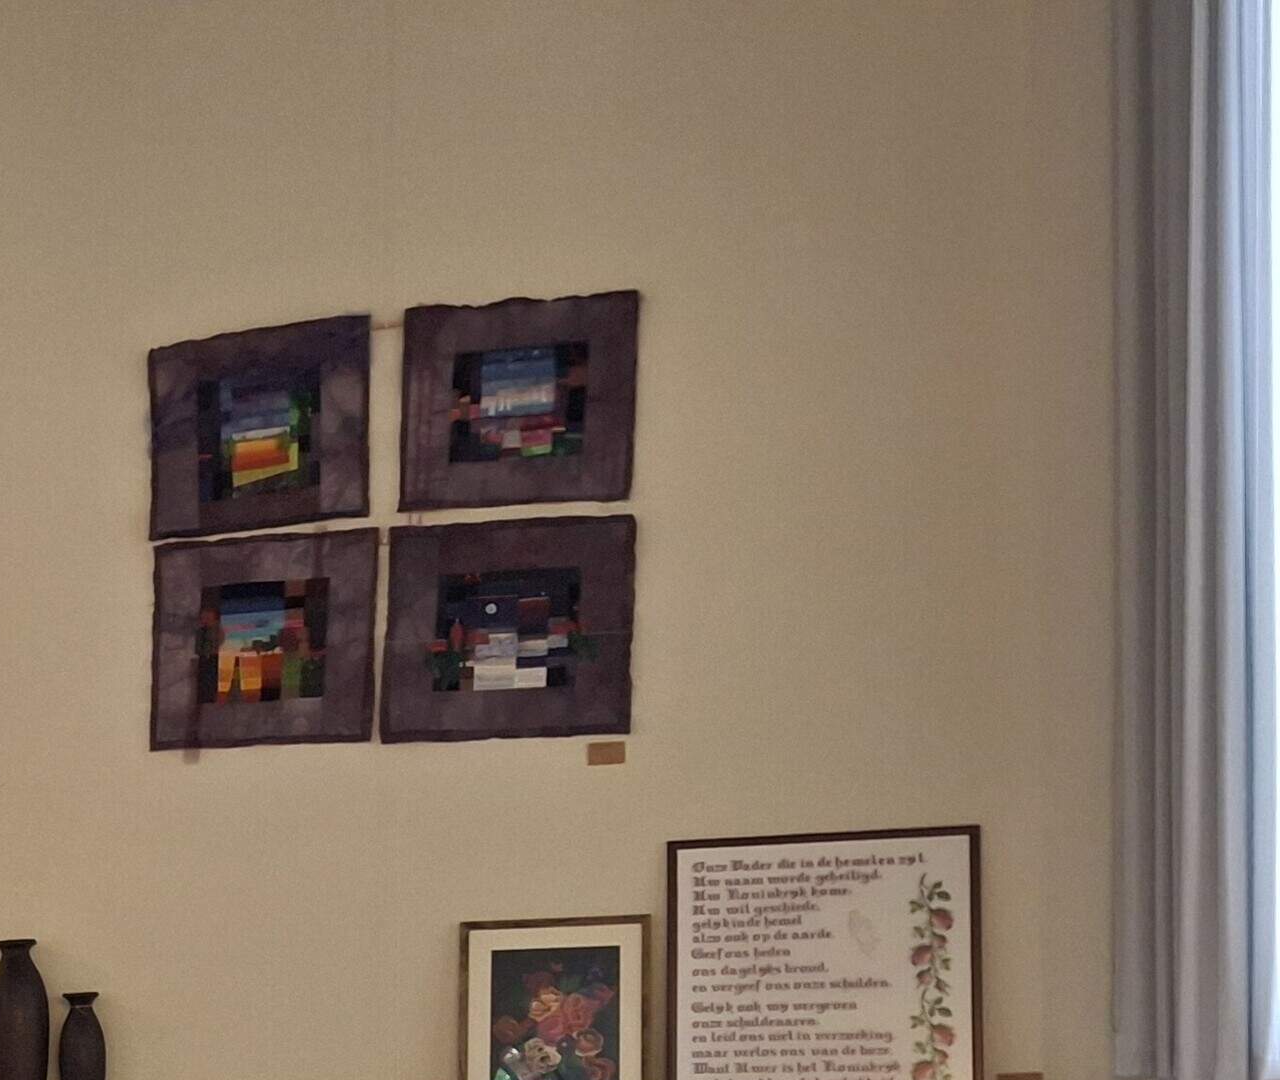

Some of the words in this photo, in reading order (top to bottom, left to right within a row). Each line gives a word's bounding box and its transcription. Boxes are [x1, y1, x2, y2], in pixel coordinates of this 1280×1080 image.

[692, 861, 727, 873] Onze
[730, 859, 771, 871] Vader
[777, 858, 796, 870] die
[800, 857, 814, 869] in
[817, 856, 832, 868] de
[835, 854, 895, 870] hemelen
[692, 876, 721, 887] Uw
[724, 876, 763, 887] naam
[768, 872, 810, 884] worde
[692, 890, 721, 902] Uw
[692, 905, 721, 916] Uw
[726, 903, 749, 915] wil
[744, 917, 761, 928] de
[764, 915, 802, 928] hemel
[724, 932, 749, 944] ook
[752, 934, 771, 945] op
[773, 930, 788, 940] de
[691, 948, 722, 960] Geef
[724, 948, 750, 959] ons
[754, 947, 791, 959] heden
[692, 967, 716, 977] ons
[692, 983, 707, 993] en
[711, 980, 760, 995] vergeef
[765, 980, 790, 990] ons
[793, 979, 826, 990] onze
[736, 1001, 761, 1014] ook
[793, 1001, 857, 1014] vergeven
[692, 1019, 723, 1029] onze
[692, 1033, 707, 1043] en
[711, 1031, 736, 1042] leid
[738, 1032, 764, 1042] ons
[768, 1030, 793, 1041] niet
[796, 1031, 811, 1041] in
[692, 1048, 728, 1058] maar
[733, 1046, 777, 1057] verlos
[780, 1046, 806, 1057] ons
[811, 1046, 838, 1056] van
[842, 1044, 856, 1055] de
[692, 1061, 730, 1075] Want
[782, 1062, 794, 1073] is
[797, 1061, 817, 1075] het
